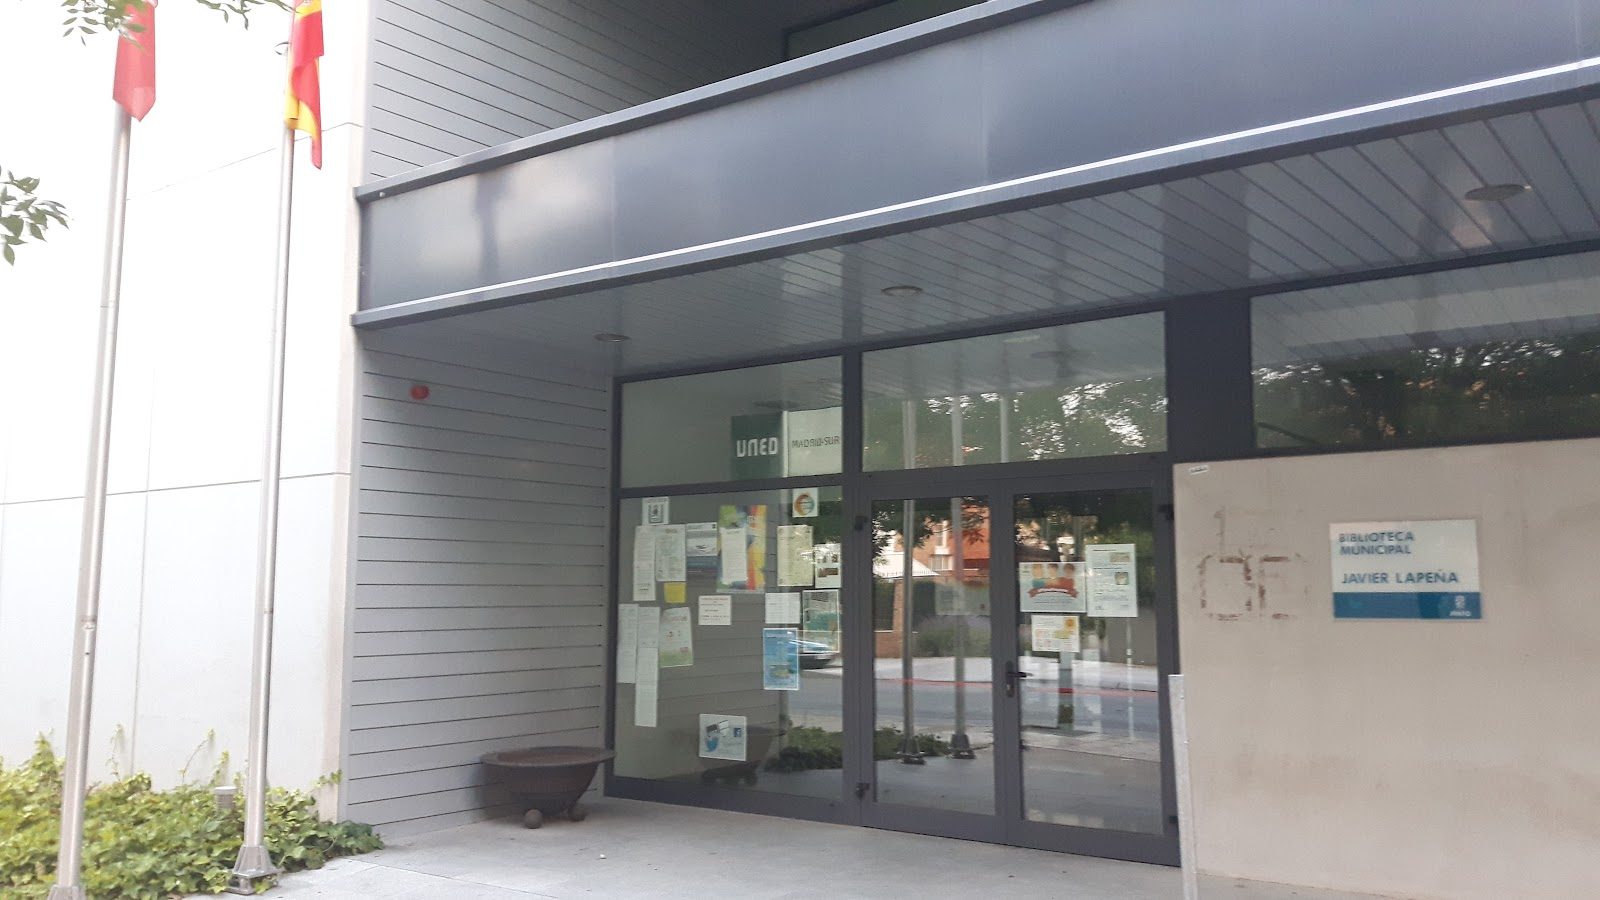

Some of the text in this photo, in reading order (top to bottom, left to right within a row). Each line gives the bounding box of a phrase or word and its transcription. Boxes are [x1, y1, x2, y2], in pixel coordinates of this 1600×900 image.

[736, 437, 778, 458] UNED
[1339, 532, 1414, 542] BIBLIOTECA
[1341, 545, 1411, 555] MUNICIPAL
[1342, 569, 1459, 583] JAVIER LAPEÑA
